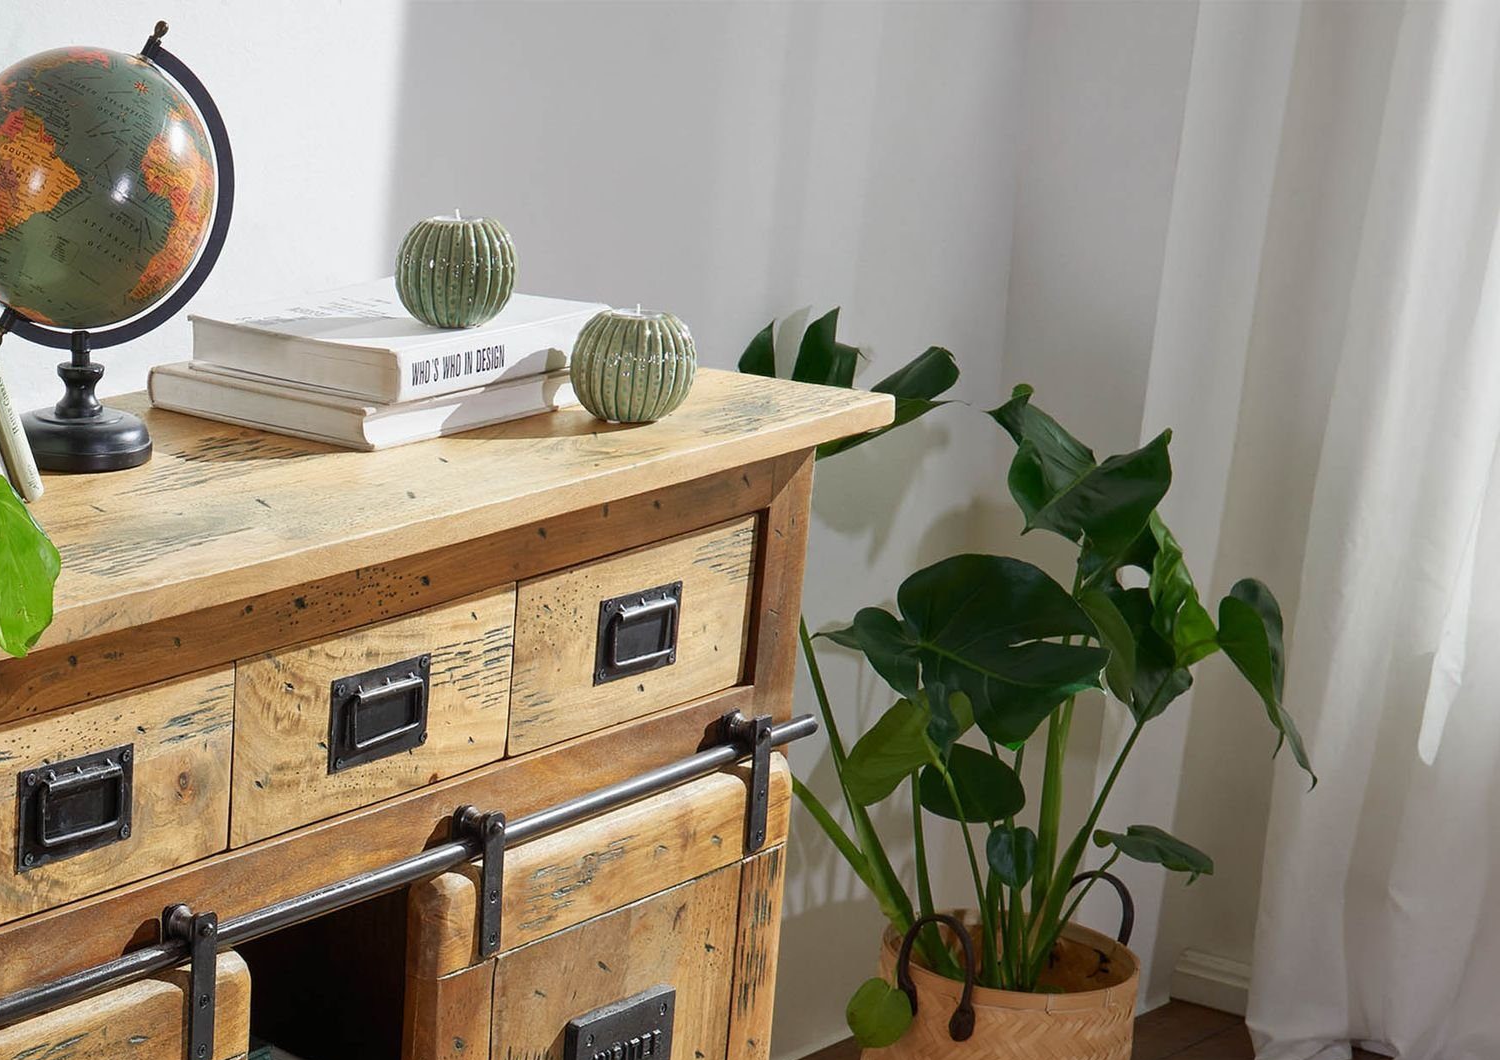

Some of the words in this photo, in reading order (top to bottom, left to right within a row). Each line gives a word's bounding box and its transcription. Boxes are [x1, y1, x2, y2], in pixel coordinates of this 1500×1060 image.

[2, 144, 34, 161] SOUTH
[412, 358, 439, 386] WHO'S
[442, 353, 461, 379] WHO
[464, 351, 473, 375] IN
[476, 344, 505, 373] DESIGN
